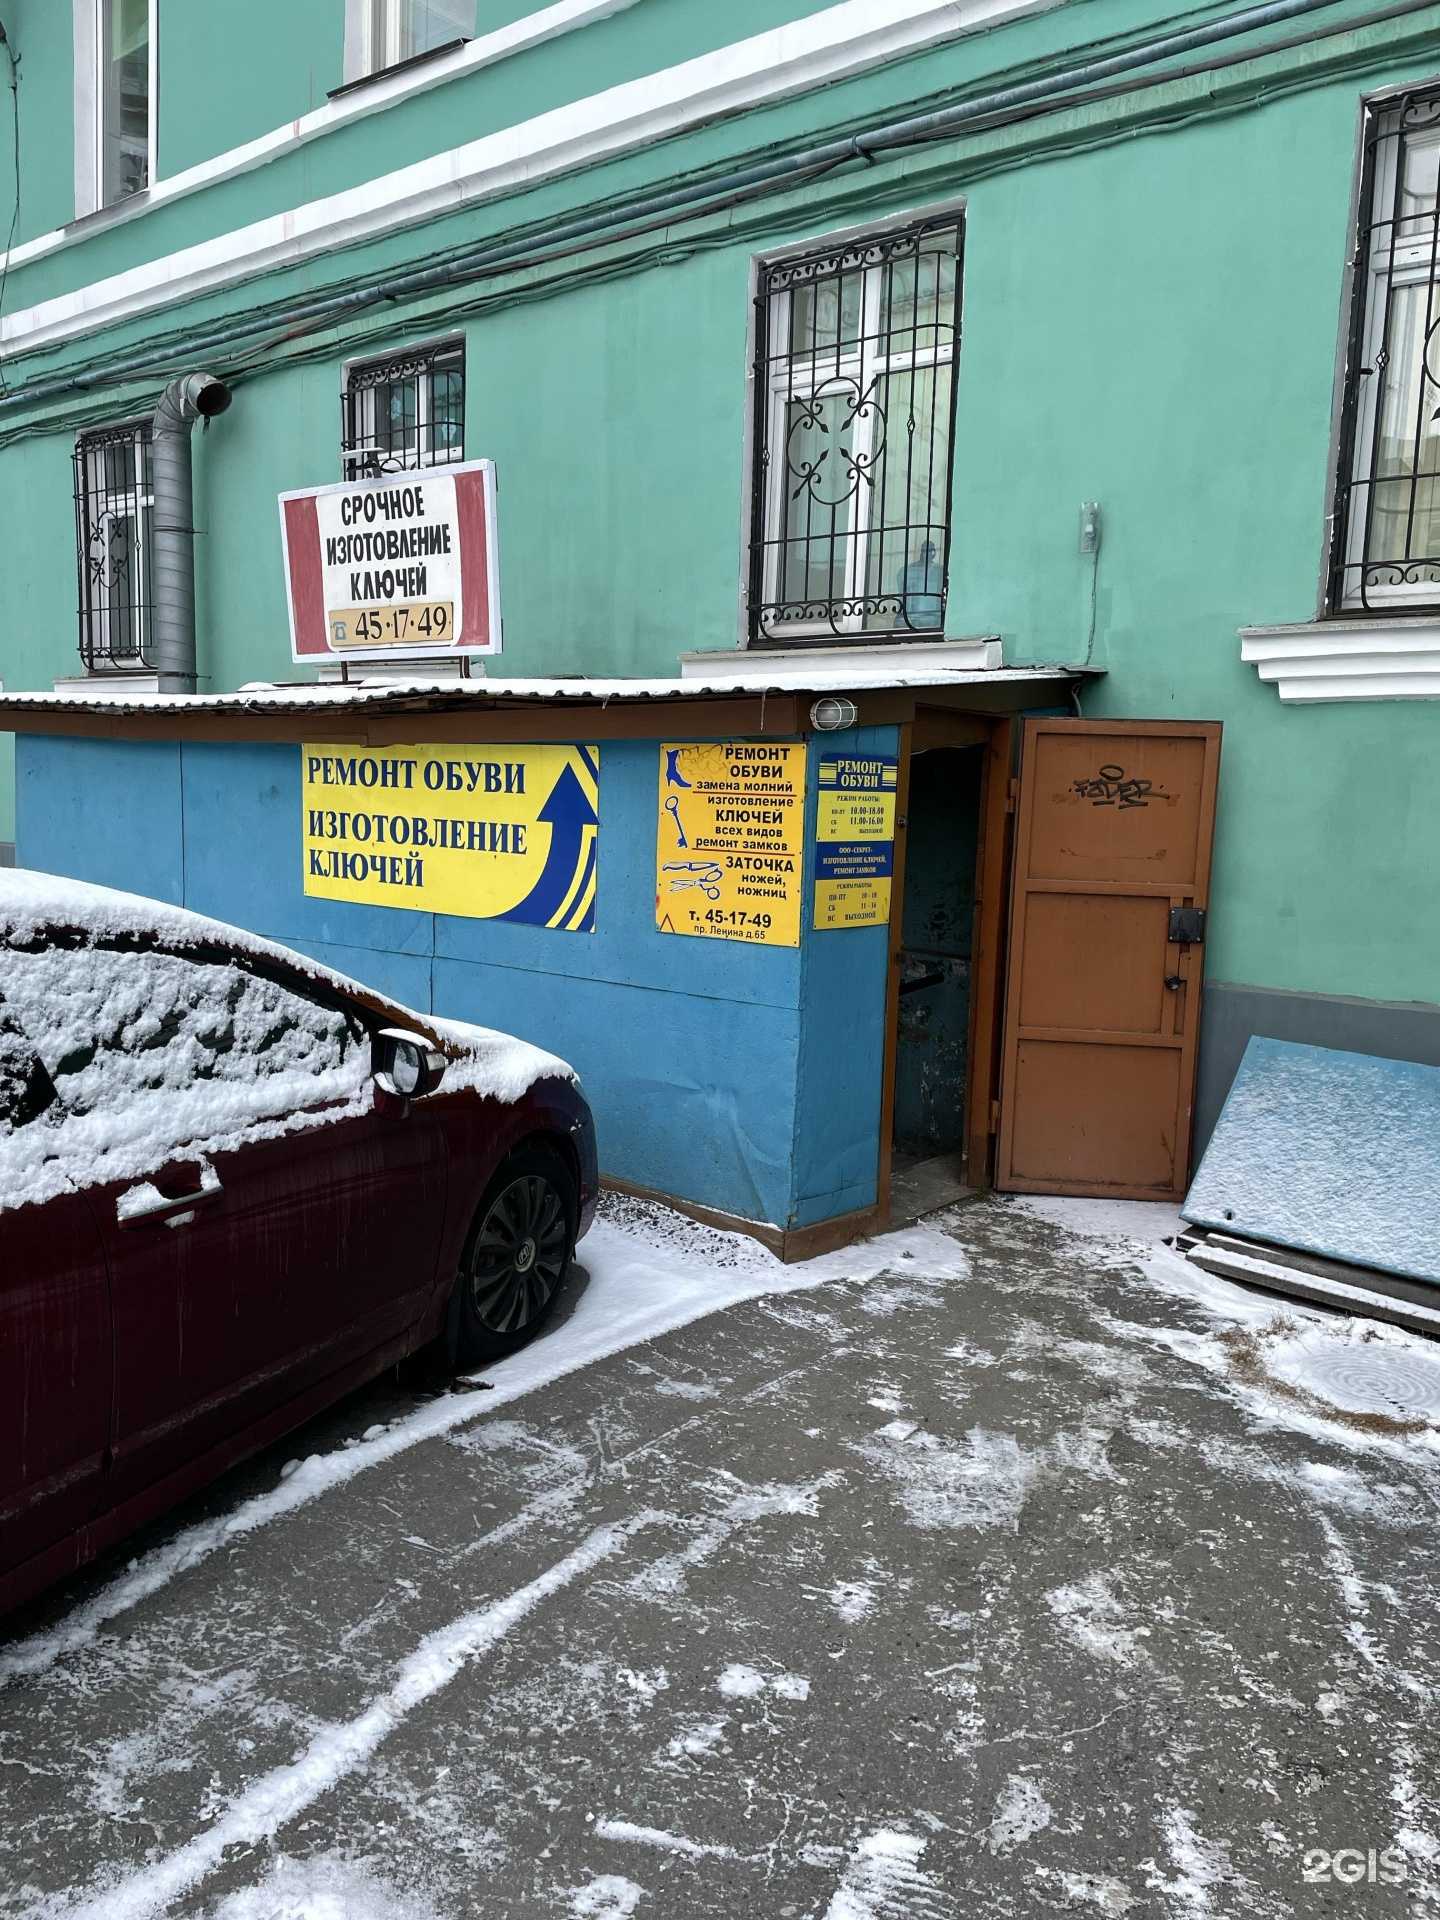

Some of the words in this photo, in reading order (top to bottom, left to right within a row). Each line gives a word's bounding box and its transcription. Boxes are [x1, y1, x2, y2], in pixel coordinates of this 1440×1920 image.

[341, 486, 424, 525] СРОЧНОЕ
[326, 523, 451, 566] ИЗГОТОВЛЕНИЕ
[350, 561, 427, 601] КЛЮЧЕЙ
[725, 747, 790, 761] РЕМОНТ
[730, 765, 783, 778] ОБУВИ
[837, 760, 883, 774] РЕМОНТ
[307, 757, 417, 789] РЕМОНТ
[423, 760, 526, 794] ОБУВИ
[841, 775, 878, 787] ОБУВИ
[696, 781, 740, 791] замена
[744, 781, 793, 792] молний
[707, 796, 794, 807] изготовление
[715, 808, 783, 824] КЛЮЧЕЙ
[308, 810, 527, 855] ИЗГОТОВЛЕНИЕ
[715, 826, 742, 836] всех
[746, 827, 783, 839] видов
[696, 837, 738, 849] ремонт
[742, 839, 788, 851] замков
[309, 850, 424, 887] КЛЮЧЕЙ
[725, 856, 794, 872] ЗАТОЧКА
[741, 873, 786, 887] ножей,
[737, 886, 787, 899] ножниц
[689, 910, 700, 921] т.
[705, 909, 772, 928] 45-17-49
[710, 925, 744, 938] Ленина
